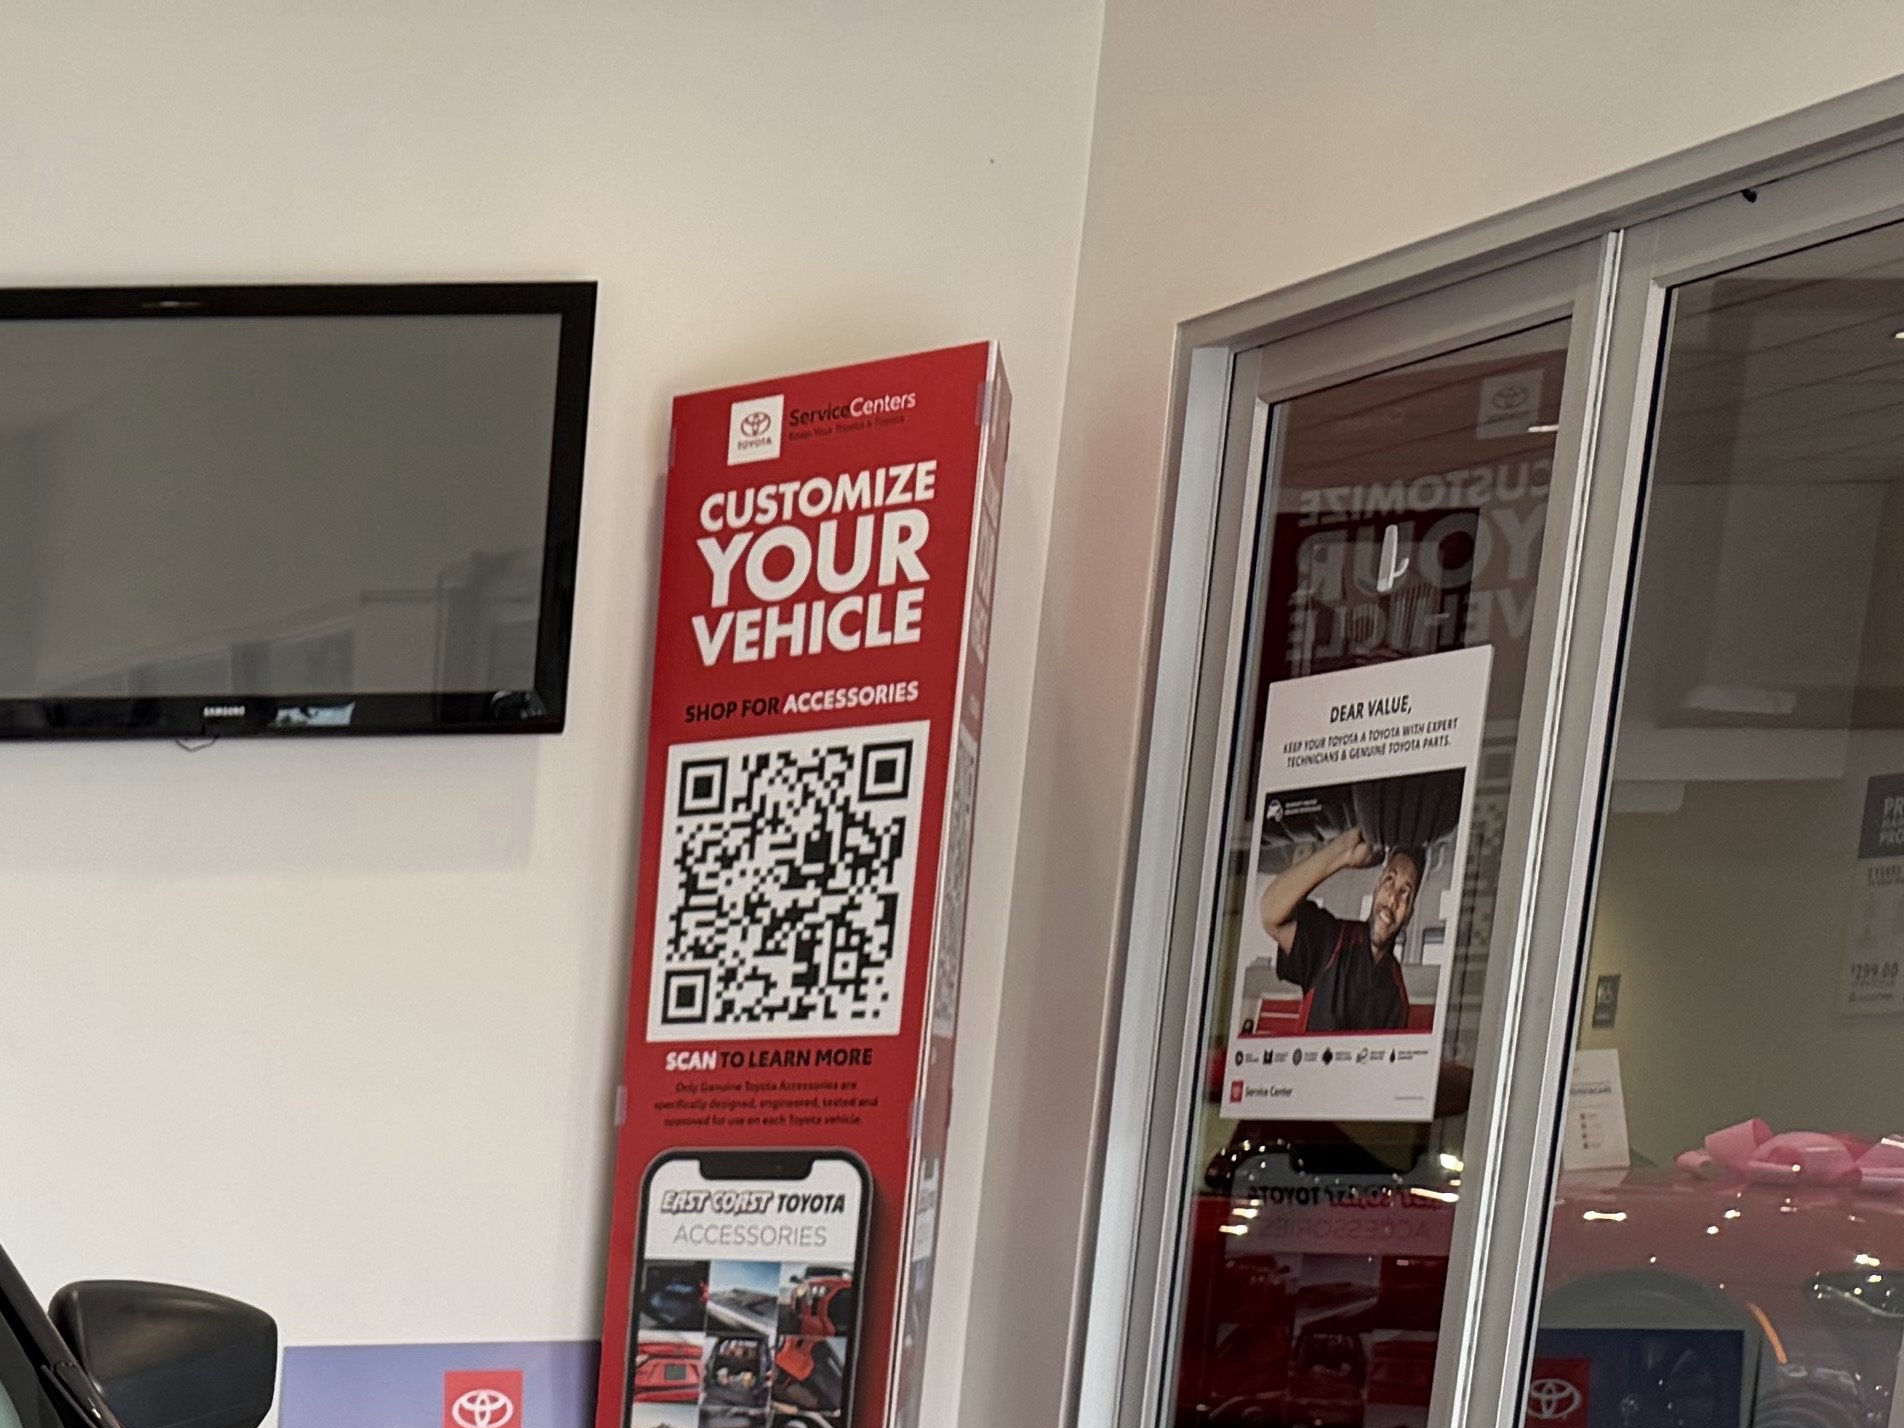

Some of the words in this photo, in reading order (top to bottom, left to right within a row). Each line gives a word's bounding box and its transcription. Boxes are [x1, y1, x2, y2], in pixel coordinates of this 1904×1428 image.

[737, 437, 772, 450] TOYOTA
[700, 460, 937, 531] CUSTOMIZE
[697, 508, 930, 608] YOUR
[692, 588, 924, 666] VEHICLE
[685, 701, 737, 723] SHOP
[742, 696, 779, 716] FOR
[783, 681, 919, 714] ACCESSORIES
[1330, 702, 1364, 723] DEAR
[1369, 695, 1412, 717] VALUE,
[1283, 741, 1302, 754] KEEP
[1304, 737, 1326, 749] YOUR
[1328, 732, 1358, 746] TOYOTA
[1360, 732, 1366, 742] A
[1368, 727, 1400, 742] TOYOTA
[1402, 723, 1424, 736] WITH
[1426, 718, 1458, 733] EXPERT
[1287, 753, 1339, 768] TECHNICIANS
[1349, 745, 1385, 759] GENUINE
[1388, 738, 1420, 754] TOYOTA
[665, 1051, 716, 1071] SCAN
[721, 1051, 745, 1068] TO
[748, 1050, 810, 1068] LEARN
[815, 1048, 872, 1066] MORE
[660, 1190, 710, 1216] EAST
[711, 1190, 774, 1217] COAST
[777, 1194, 846, 1214] TOYOTA
[673, 1224, 827, 1246] ACCESSORIES
